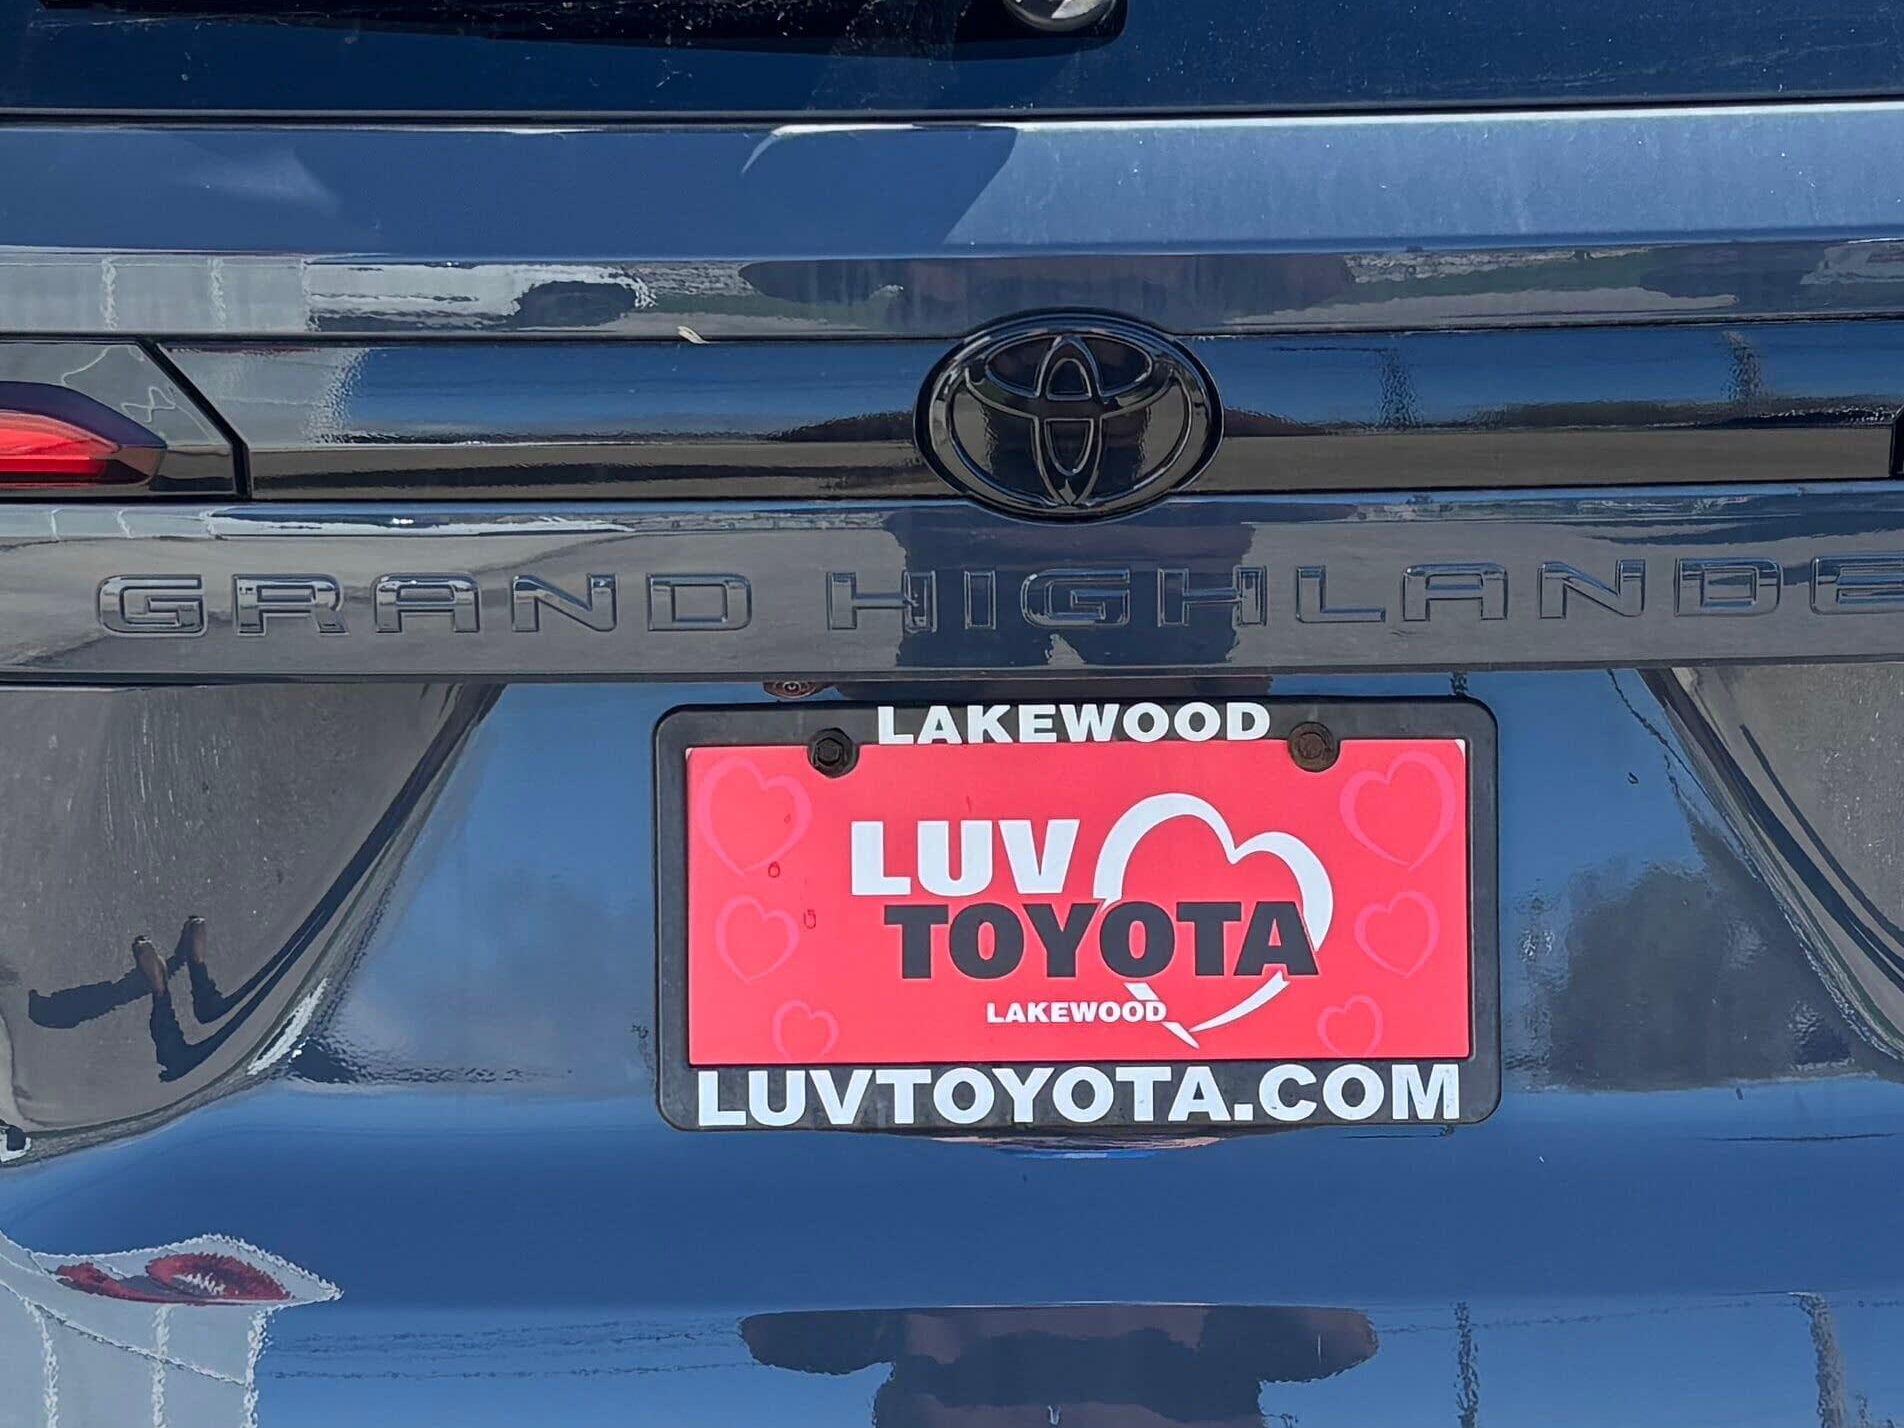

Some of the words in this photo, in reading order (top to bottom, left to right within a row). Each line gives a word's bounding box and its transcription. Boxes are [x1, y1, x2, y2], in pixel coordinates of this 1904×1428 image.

[97, 572, 754, 639] GRAND
[876, 702, 1271, 746] LAKEWOOD
[850, 818, 1080, 897] LUV
[884, 901, 1319, 980] TOYOTA
[986, 1001, 1168, 1024] LAKEWOOD
[698, 1064, 1460, 1128] LUVTOYOTA.COM
